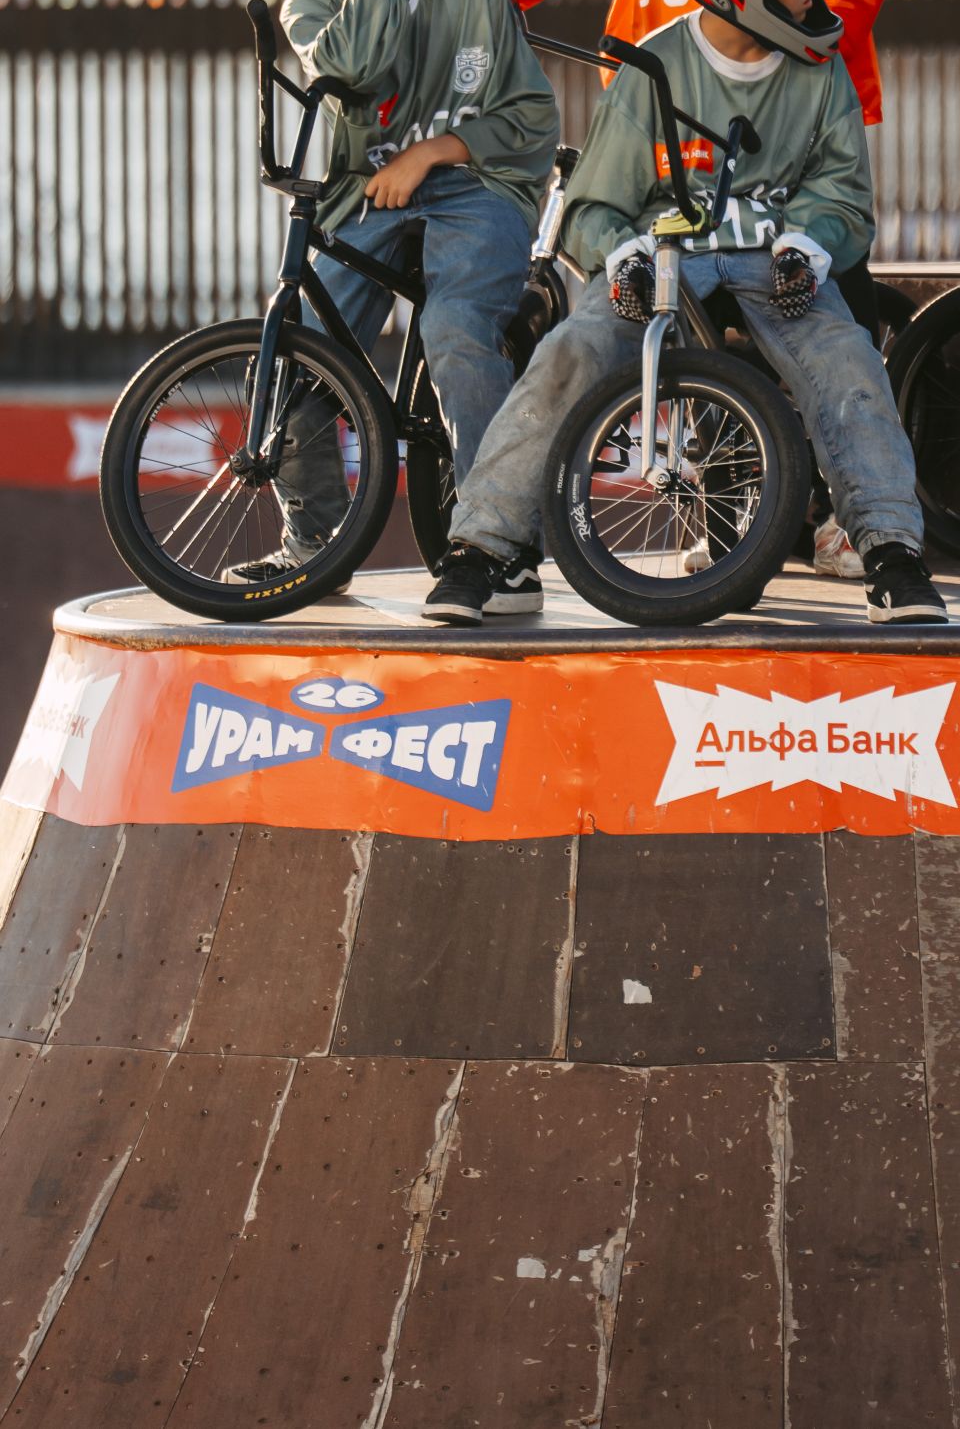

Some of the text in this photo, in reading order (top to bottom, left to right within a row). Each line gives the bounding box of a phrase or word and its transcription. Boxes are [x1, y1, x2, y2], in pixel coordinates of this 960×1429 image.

[244, 573, 308, 600] MAXXIS
[297, 683, 378, 708] 26
[186, 702, 497, 787] УРАМ ФЕСТ
[695, 722, 920, 767] Альфа Банк
